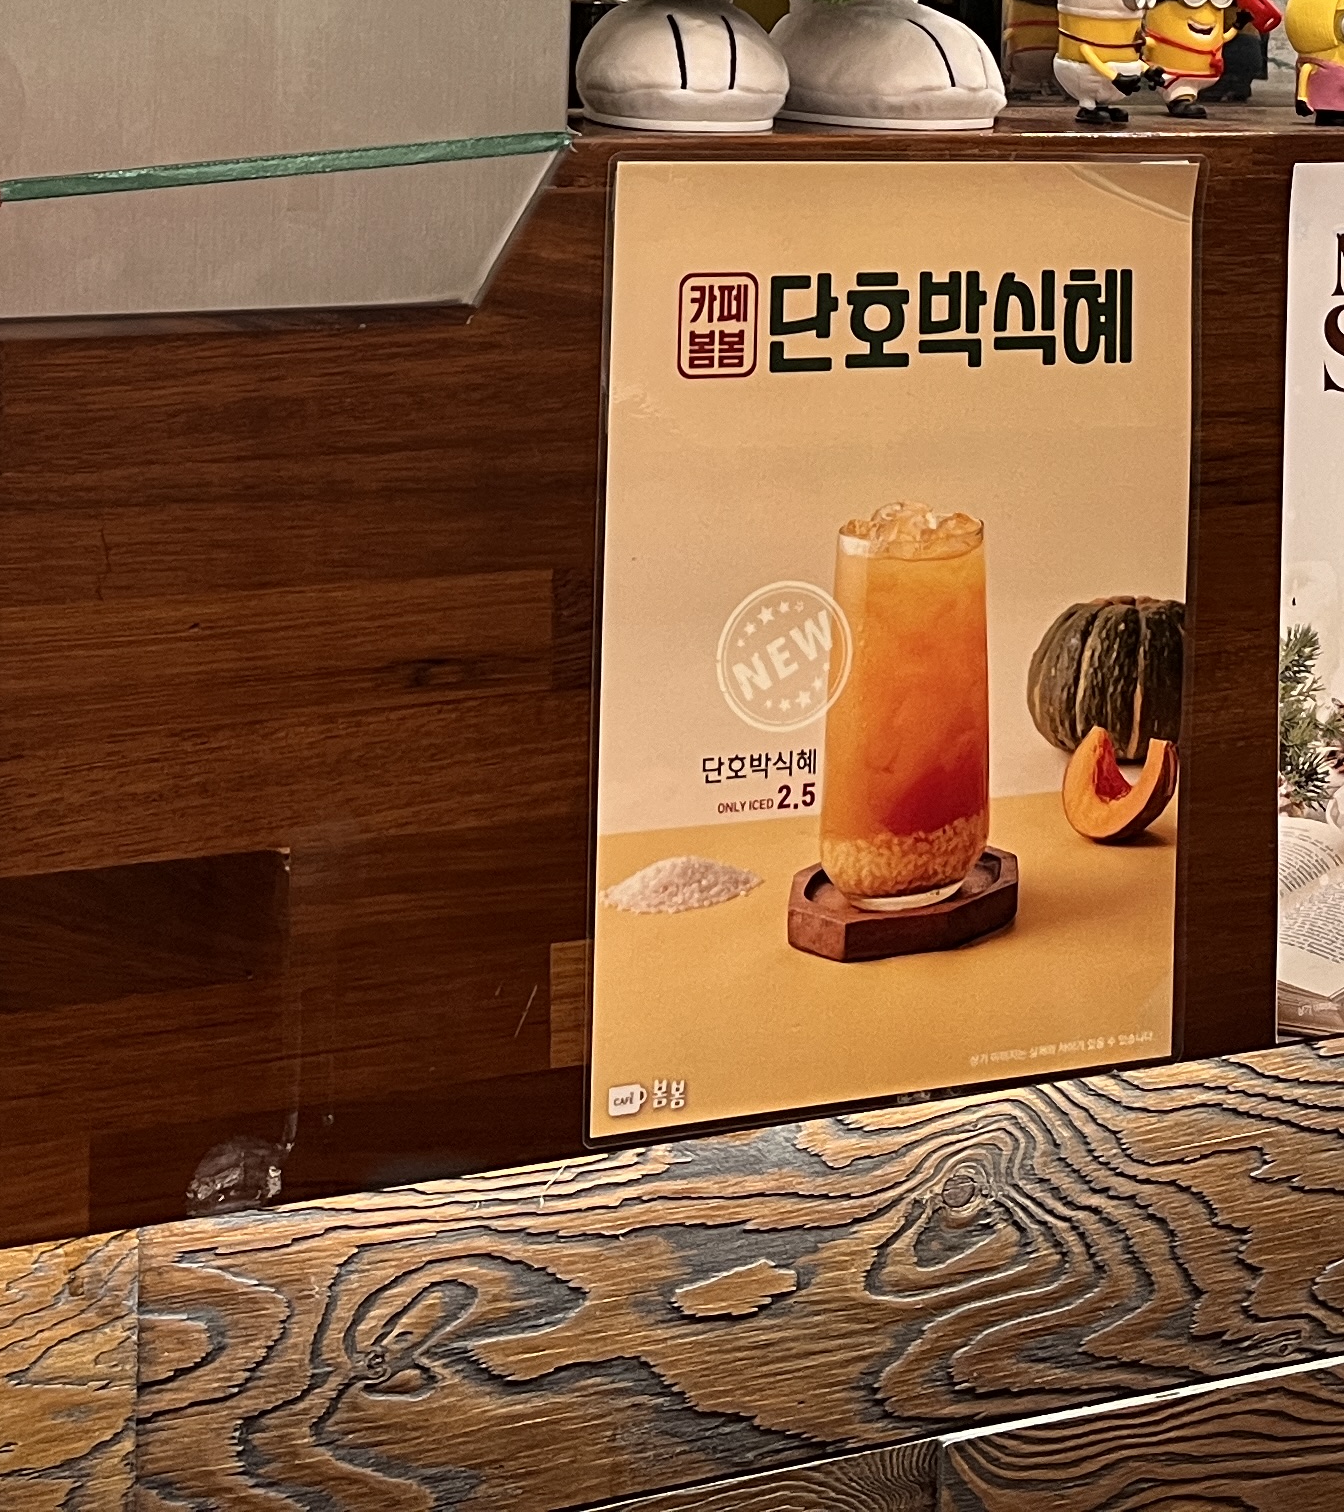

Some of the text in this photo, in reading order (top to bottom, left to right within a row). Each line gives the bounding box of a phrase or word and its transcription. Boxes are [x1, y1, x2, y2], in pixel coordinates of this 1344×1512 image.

[690, 283, 749, 323] 카페
[768, 268, 1133, 373] 단호박식혜
[688, 329, 745, 369] 봄봄
[732, 609, 833, 702] NEW
[702, 748, 817, 784] 단호박식혜
[718, 782, 816, 814] ONLY ICED 2.5
[652, 1079, 686, 1109] 봄봄
